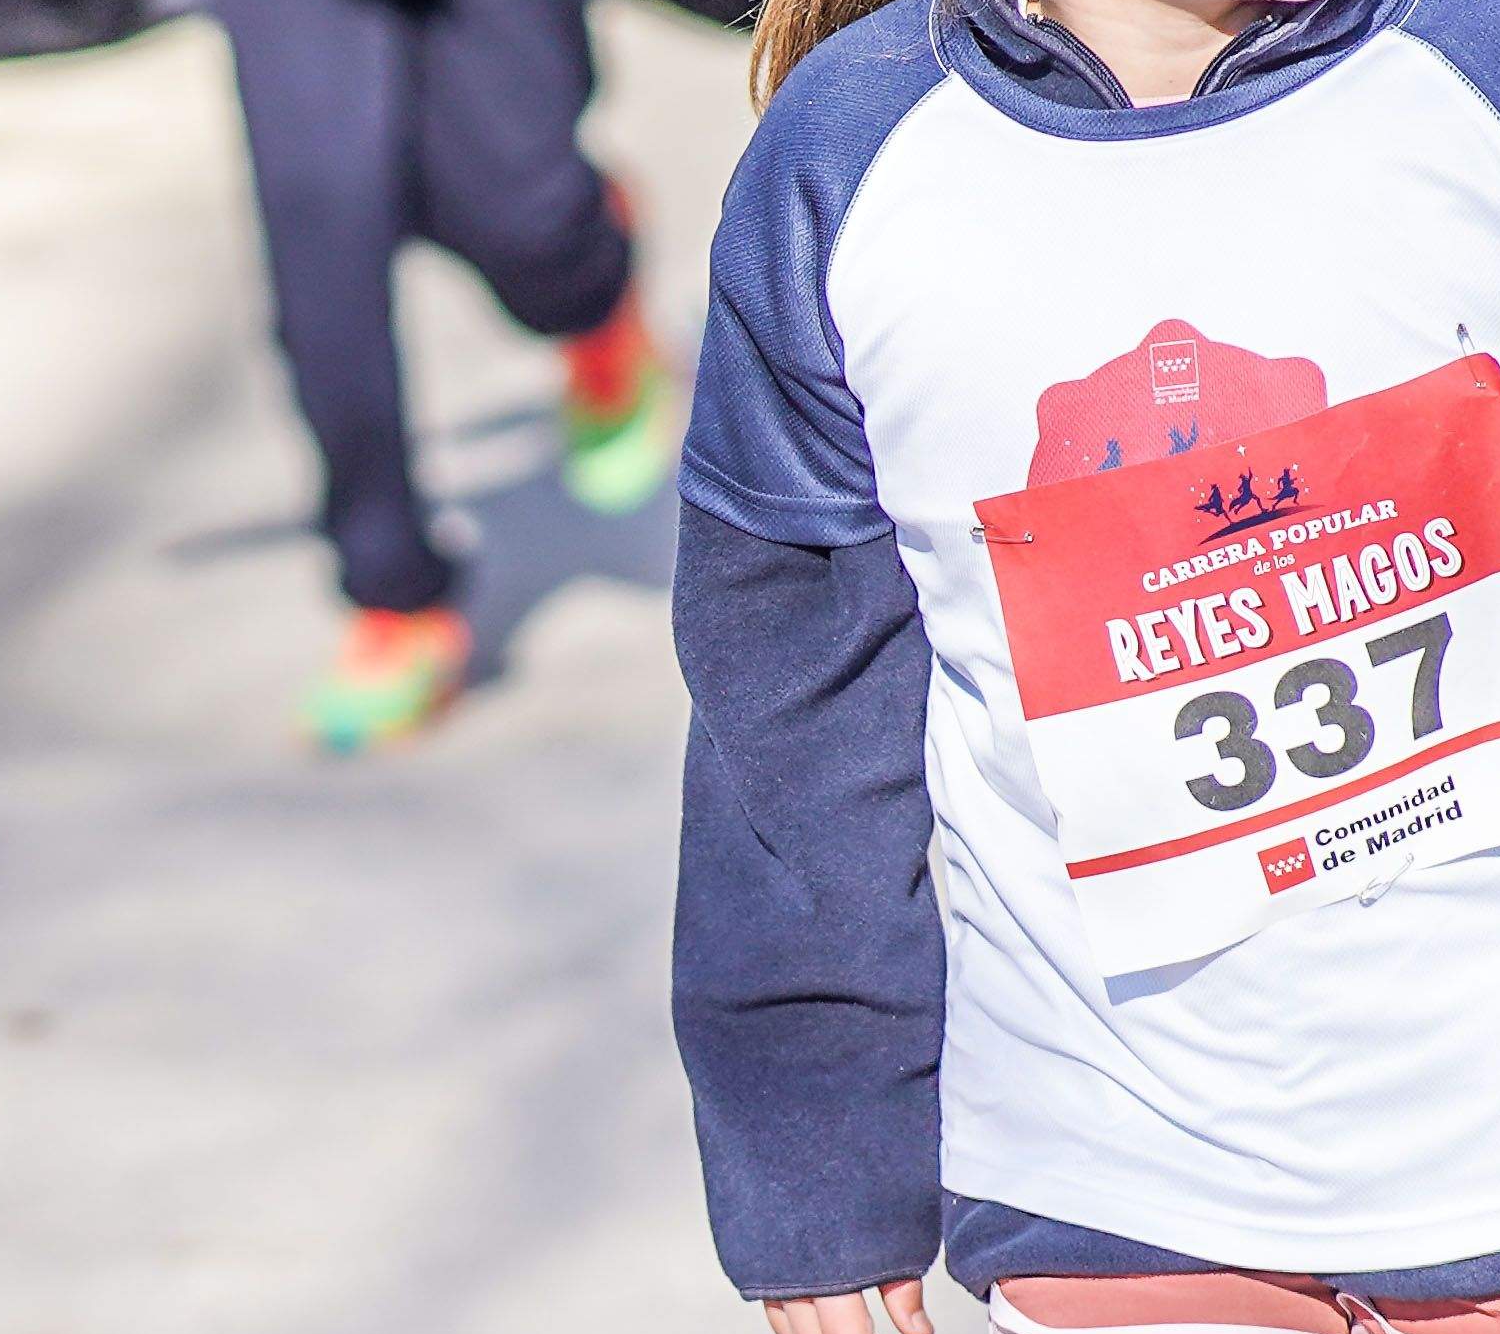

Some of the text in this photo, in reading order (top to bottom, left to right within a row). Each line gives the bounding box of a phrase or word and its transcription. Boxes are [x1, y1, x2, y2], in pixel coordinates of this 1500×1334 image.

[1141, 499, 1399, 593] CARRERA POPULAR
[1253, 553, 1296, 576] de los
[1105, 517, 1464, 684] REYES MAGOS
[1174, 611, 1453, 812] 337
[1315, 775, 1456, 846] Comunidad
[1322, 800, 1463, 871] de Madrid
